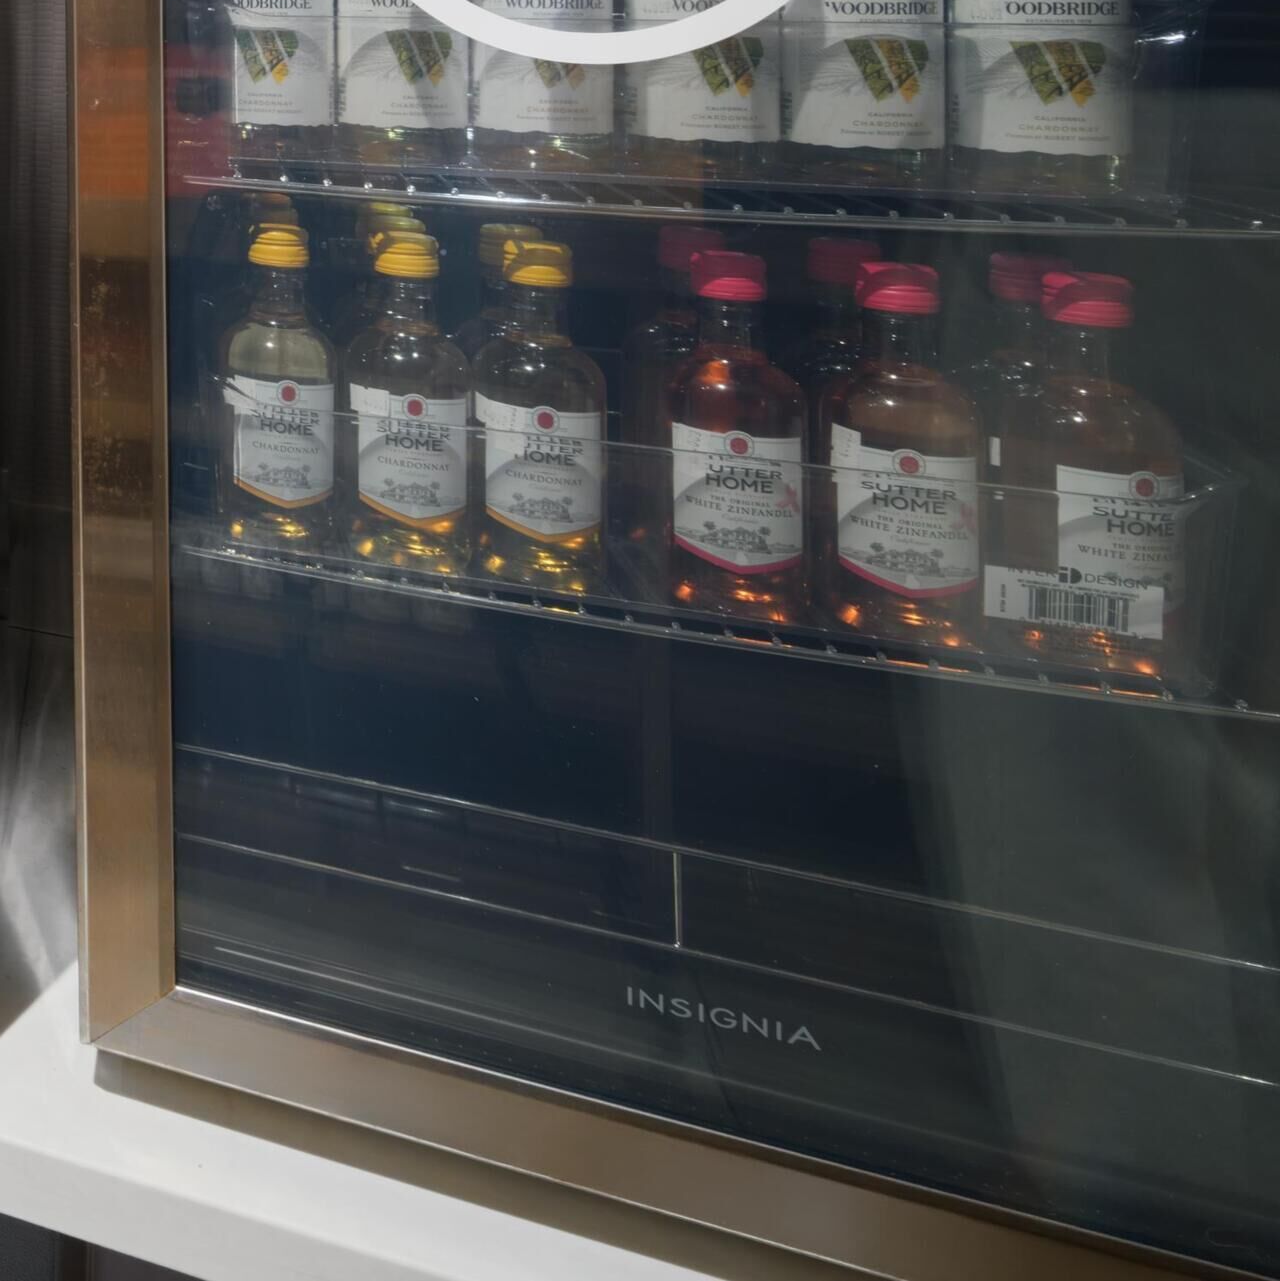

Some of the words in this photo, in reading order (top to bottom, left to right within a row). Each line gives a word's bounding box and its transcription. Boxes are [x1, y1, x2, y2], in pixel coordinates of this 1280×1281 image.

[1005, 1, 1121, 16] OODBRIDGE
[260, 419, 315, 436] HOME
[252, 440, 320, 455] CHARDONNAY
[385, 433, 445, 452] HOME
[377, 455, 450, 472] CHARDONNAY
[708, 463, 783, 481] UTTER
[505, 469, 583, 486] CHARDONNAY
[705, 473, 775, 494] HOME
[861, 480, 957, 501] SUTTER
[686, 495, 723, 511] WHITE
[727, 504, 794, 518] ZINFANDEL
[710, 494, 726, 503] THE
[729, 497, 771, 508] ORIGINAL
[872, 491, 948, 515] HOME
[877, 514, 895, 523] THE
[898, 518, 944, 530] ORIGINAL
[1092, 505, 1175, 522] SUTTE
[850, 514, 890, 532] WHITE
[1106, 519, 1176, 537] HOME
[1077, 543, 1127, 561] WHITE
[1083, 574, 1149, 591] DESIGN
[626, 986, 822, 1051] INSIGNIA
